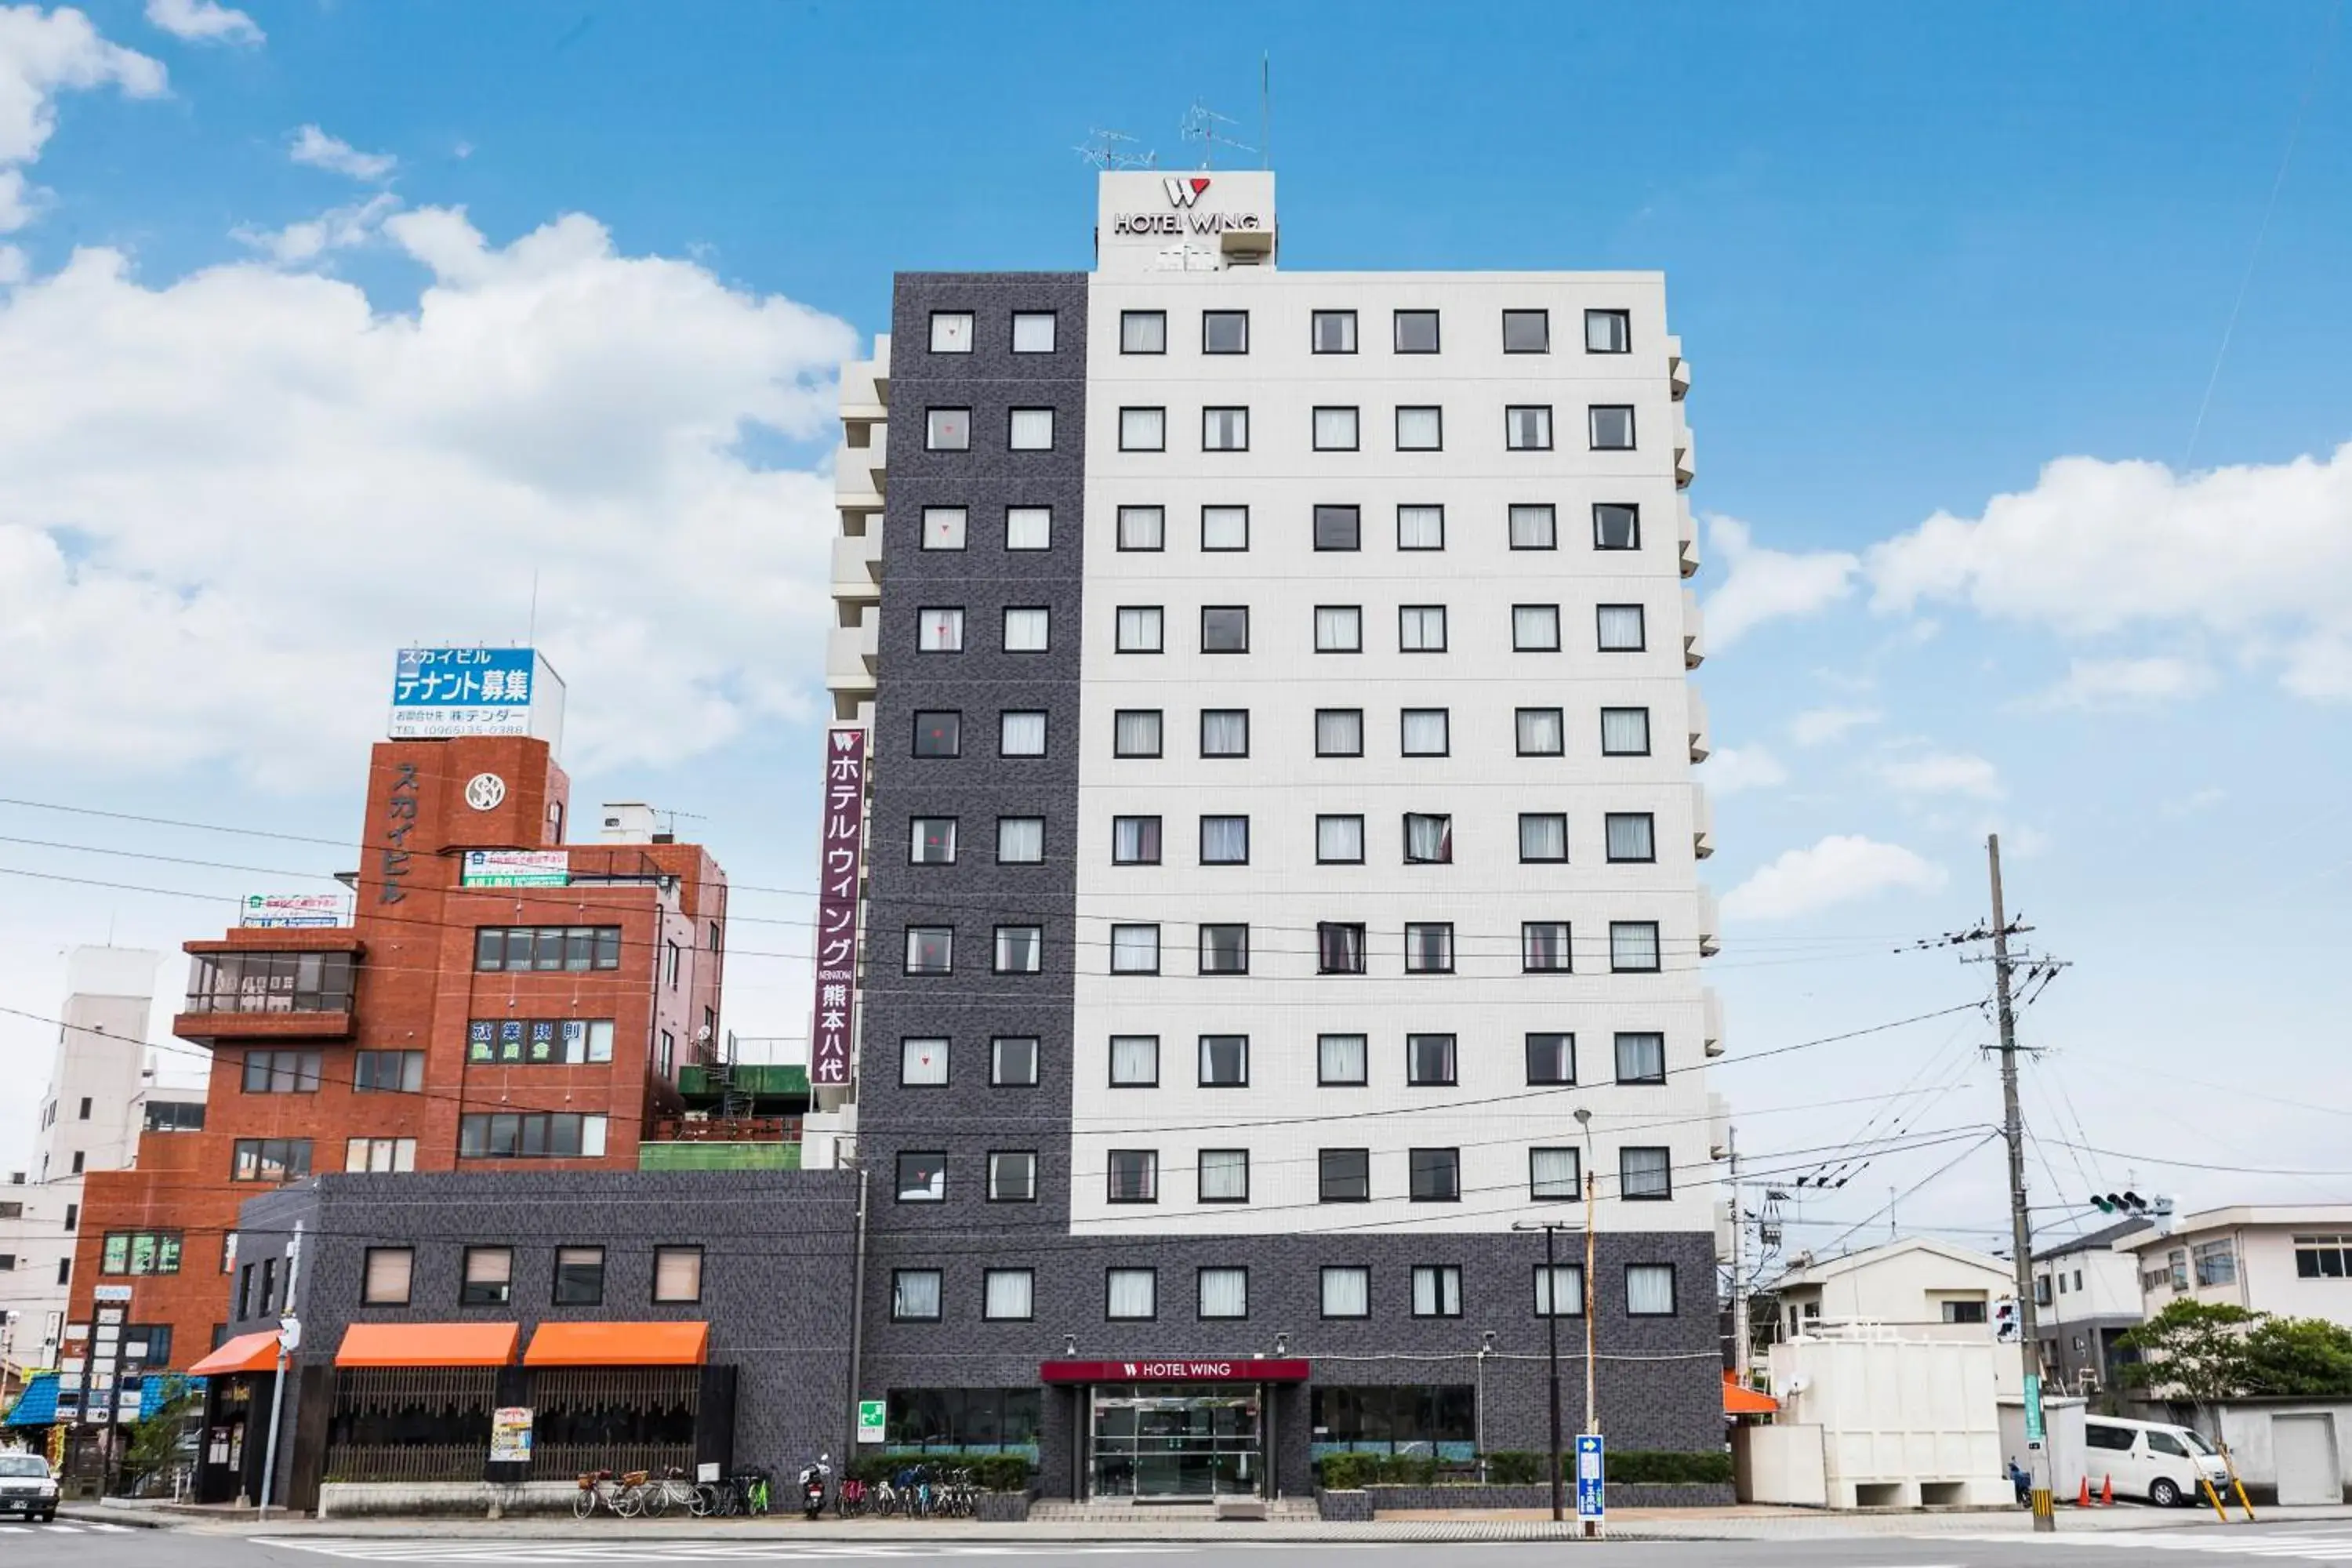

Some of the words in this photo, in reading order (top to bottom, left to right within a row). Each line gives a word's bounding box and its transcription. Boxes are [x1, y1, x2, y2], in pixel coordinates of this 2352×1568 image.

[1114, 212, 1184, 234] HOTEL
[1187, 212, 1260, 234] WING
[401, 649, 492, 665] スカイビル
[397, 669, 529, 702] テナント募集
[396, 725, 416, 735] TEL
[379, 761, 419, 905] スカイビル
[823, 755, 859, 967] ホテルウィング
[470, 1022, 582, 1040] 就業規則
[818, 984, 846, 1082] 熊本八代
[1143, 1363, 1187, 1376] HOTEL
[1189, 1363, 1232, 1376] WING
